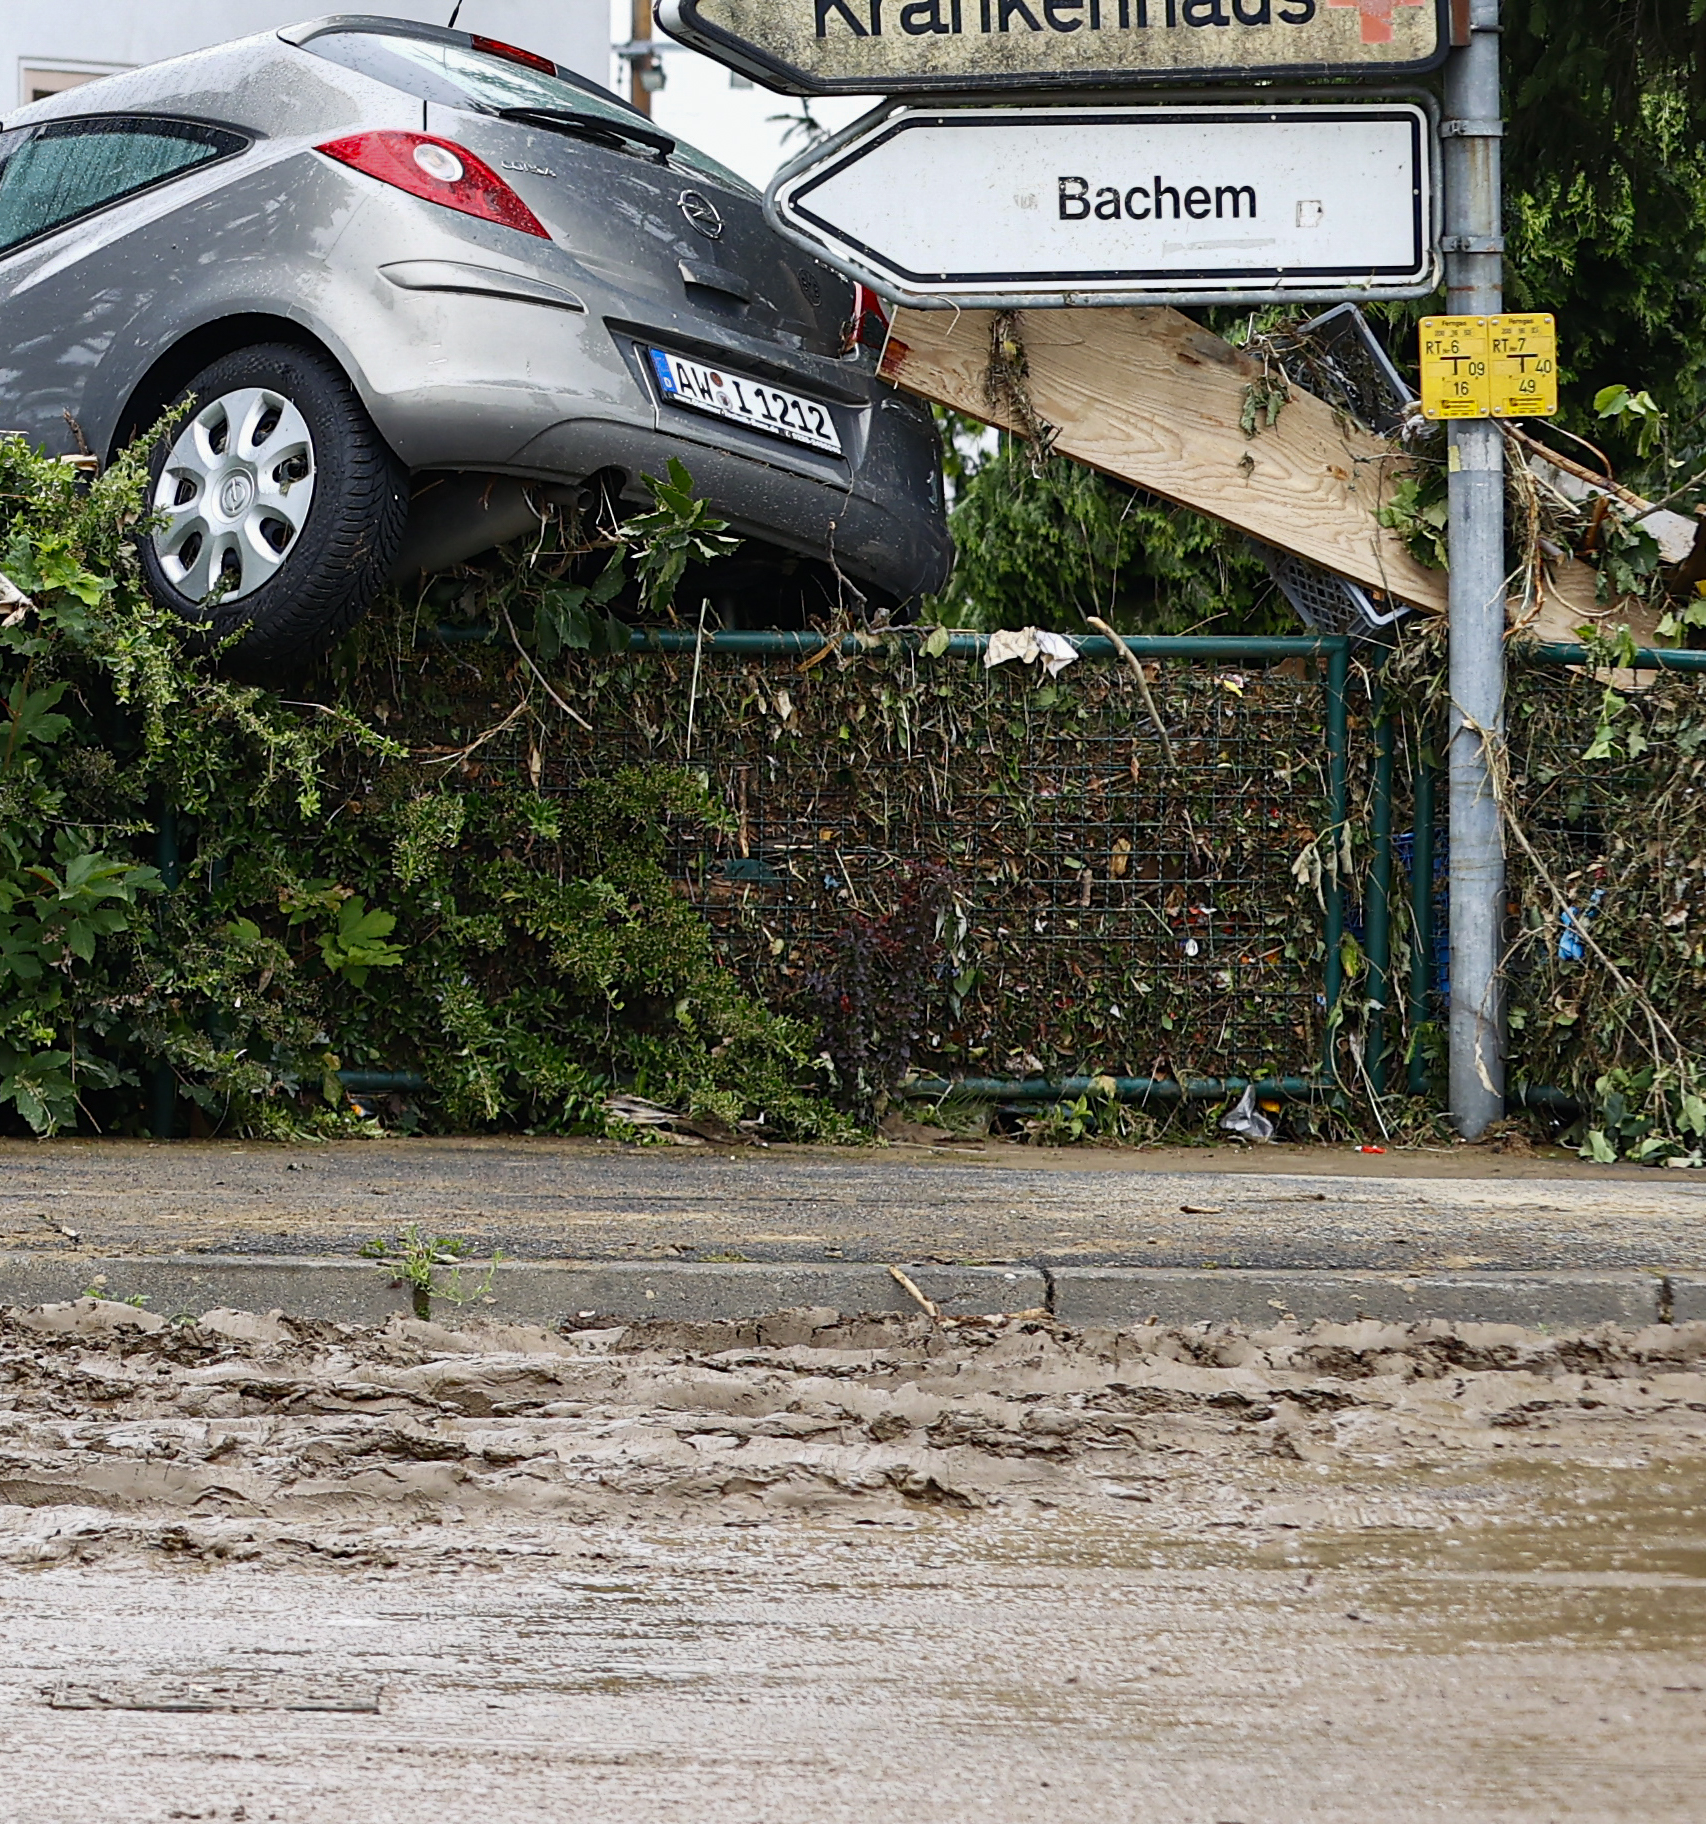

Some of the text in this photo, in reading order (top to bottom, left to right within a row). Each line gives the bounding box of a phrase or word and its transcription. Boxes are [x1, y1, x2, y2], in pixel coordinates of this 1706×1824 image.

[1058, 175, 1257, 221] Bachem
[675, 362, 714, 403] AW
[754, 387, 832, 441] 1212
